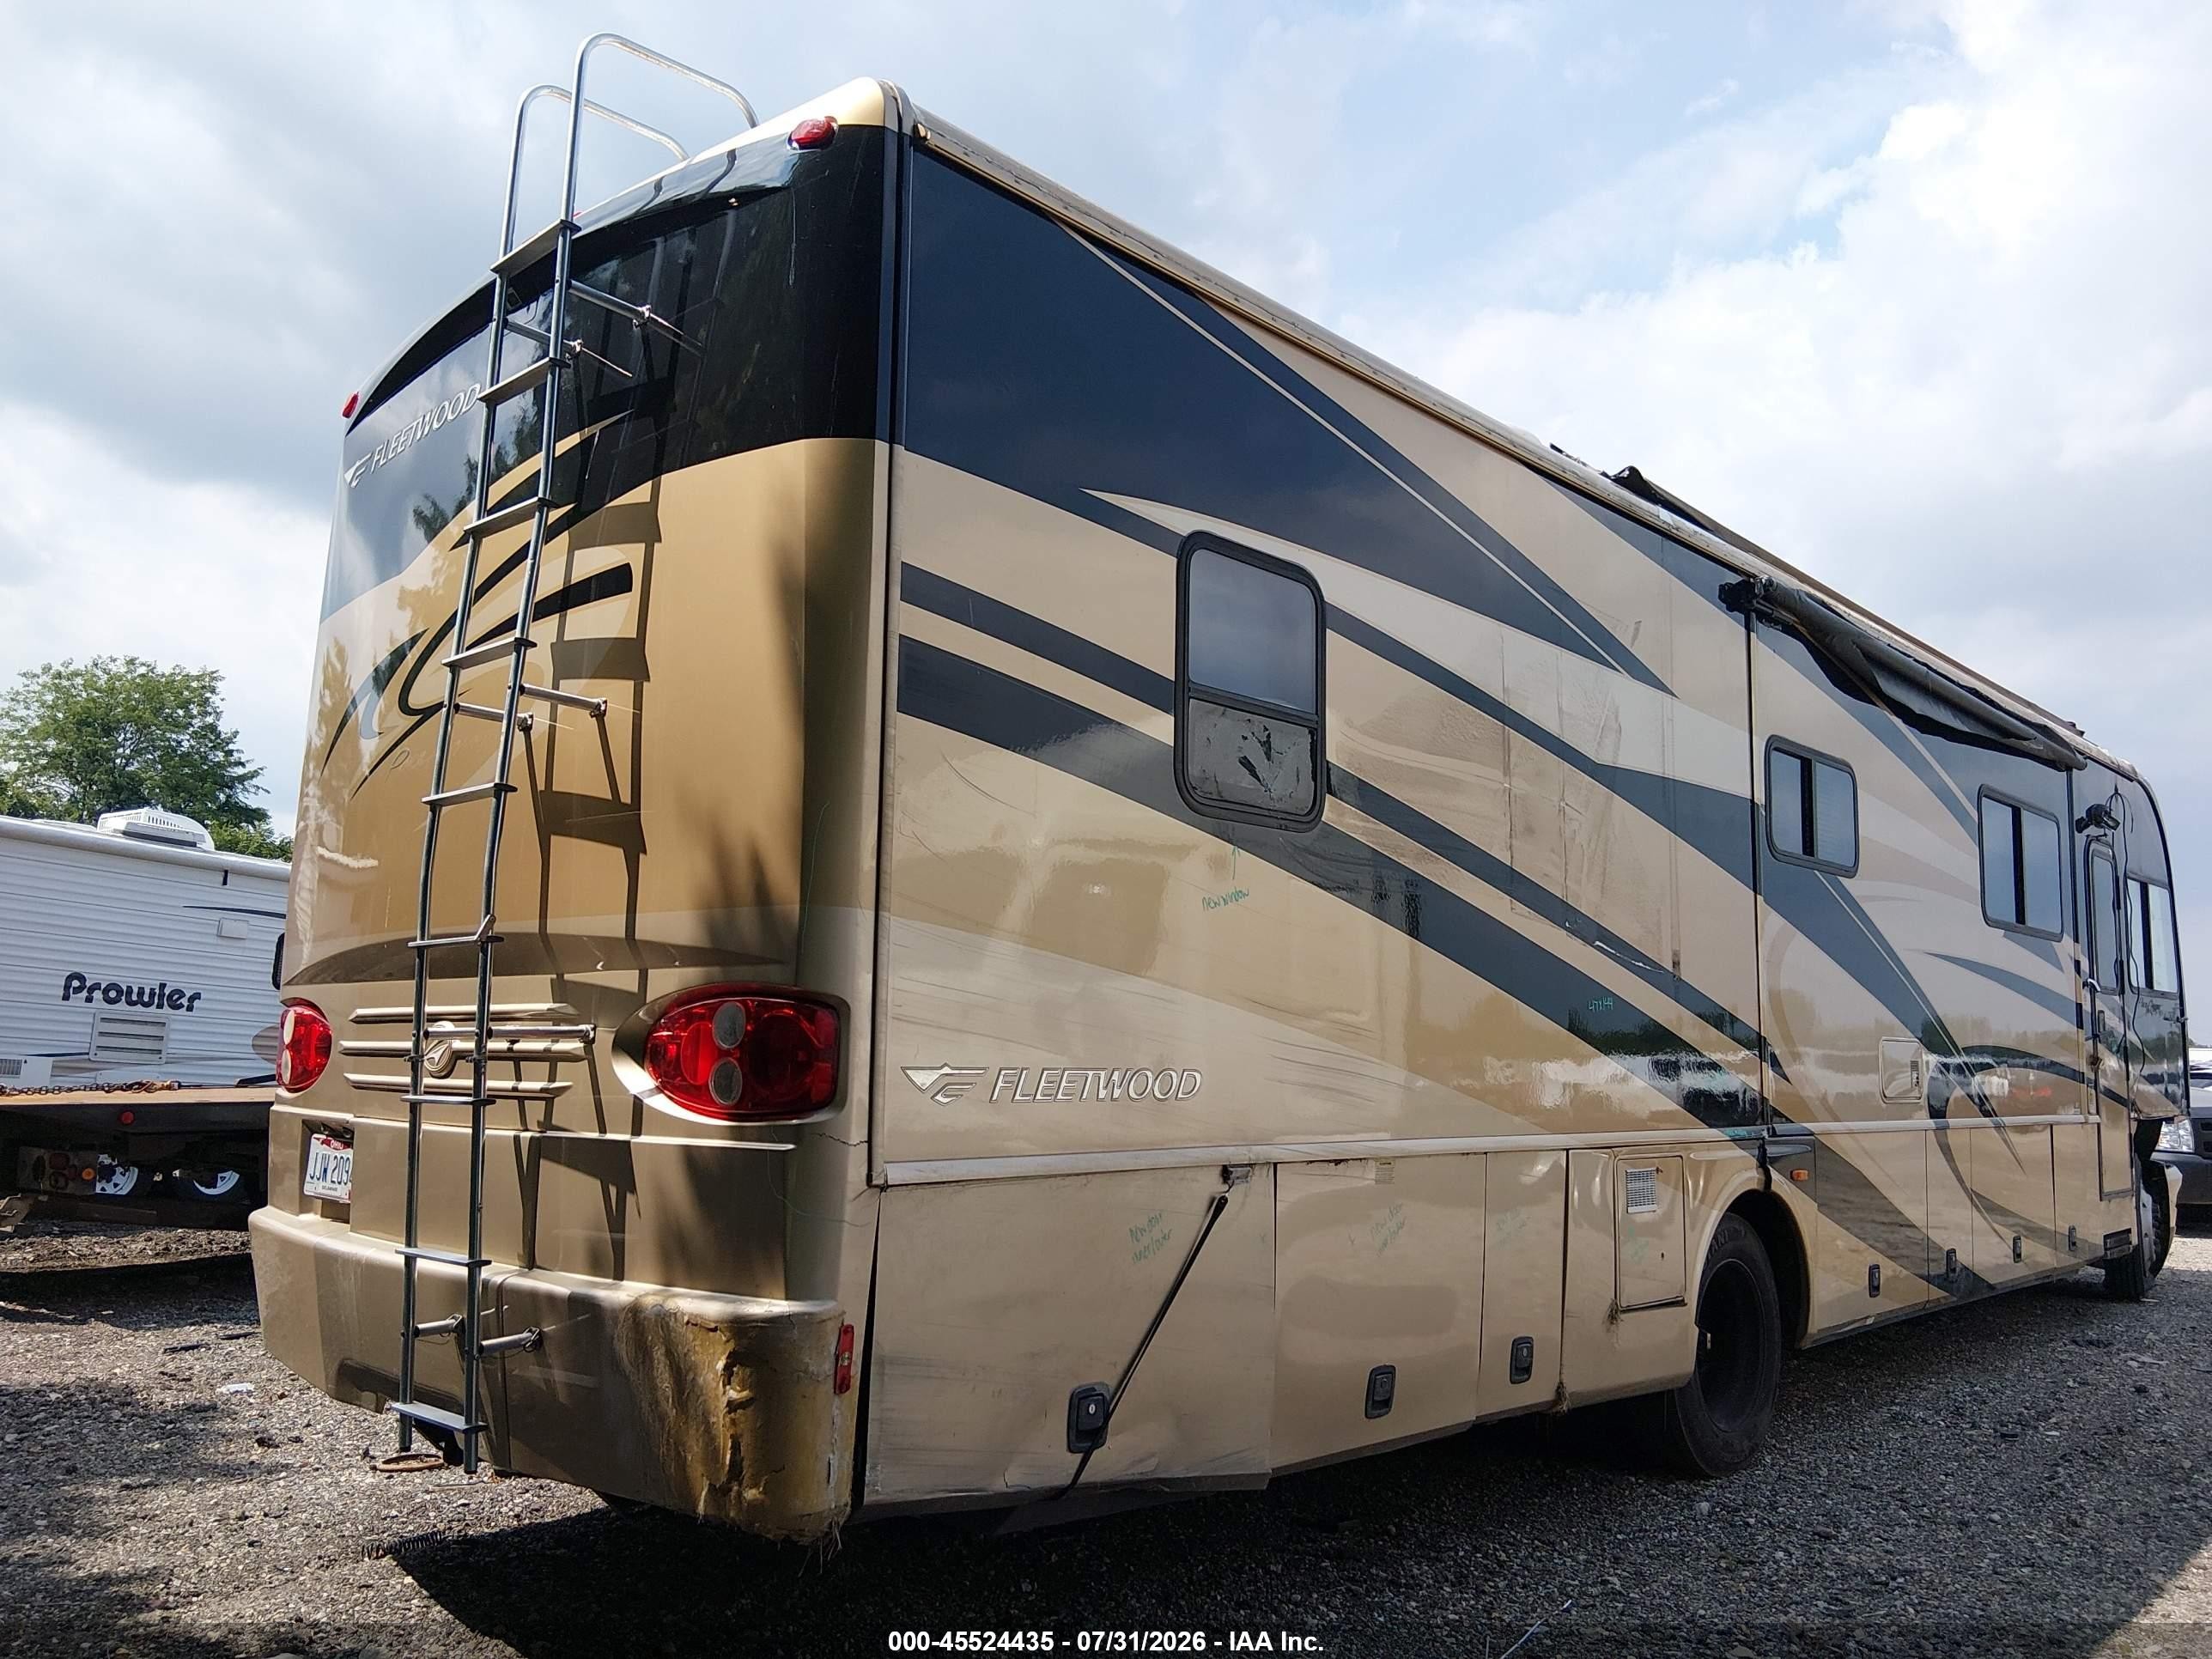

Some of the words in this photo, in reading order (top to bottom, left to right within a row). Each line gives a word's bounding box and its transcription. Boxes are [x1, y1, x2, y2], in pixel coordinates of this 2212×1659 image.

[370, 383, 481, 475] FLEETWOOD
[62, 971, 201, 1012] Prowler
[988, 1066, 1202, 1103] FLEETWOOD
[309, 1152, 331, 1183] JJW
[330, 1154, 352, 1186] 209
